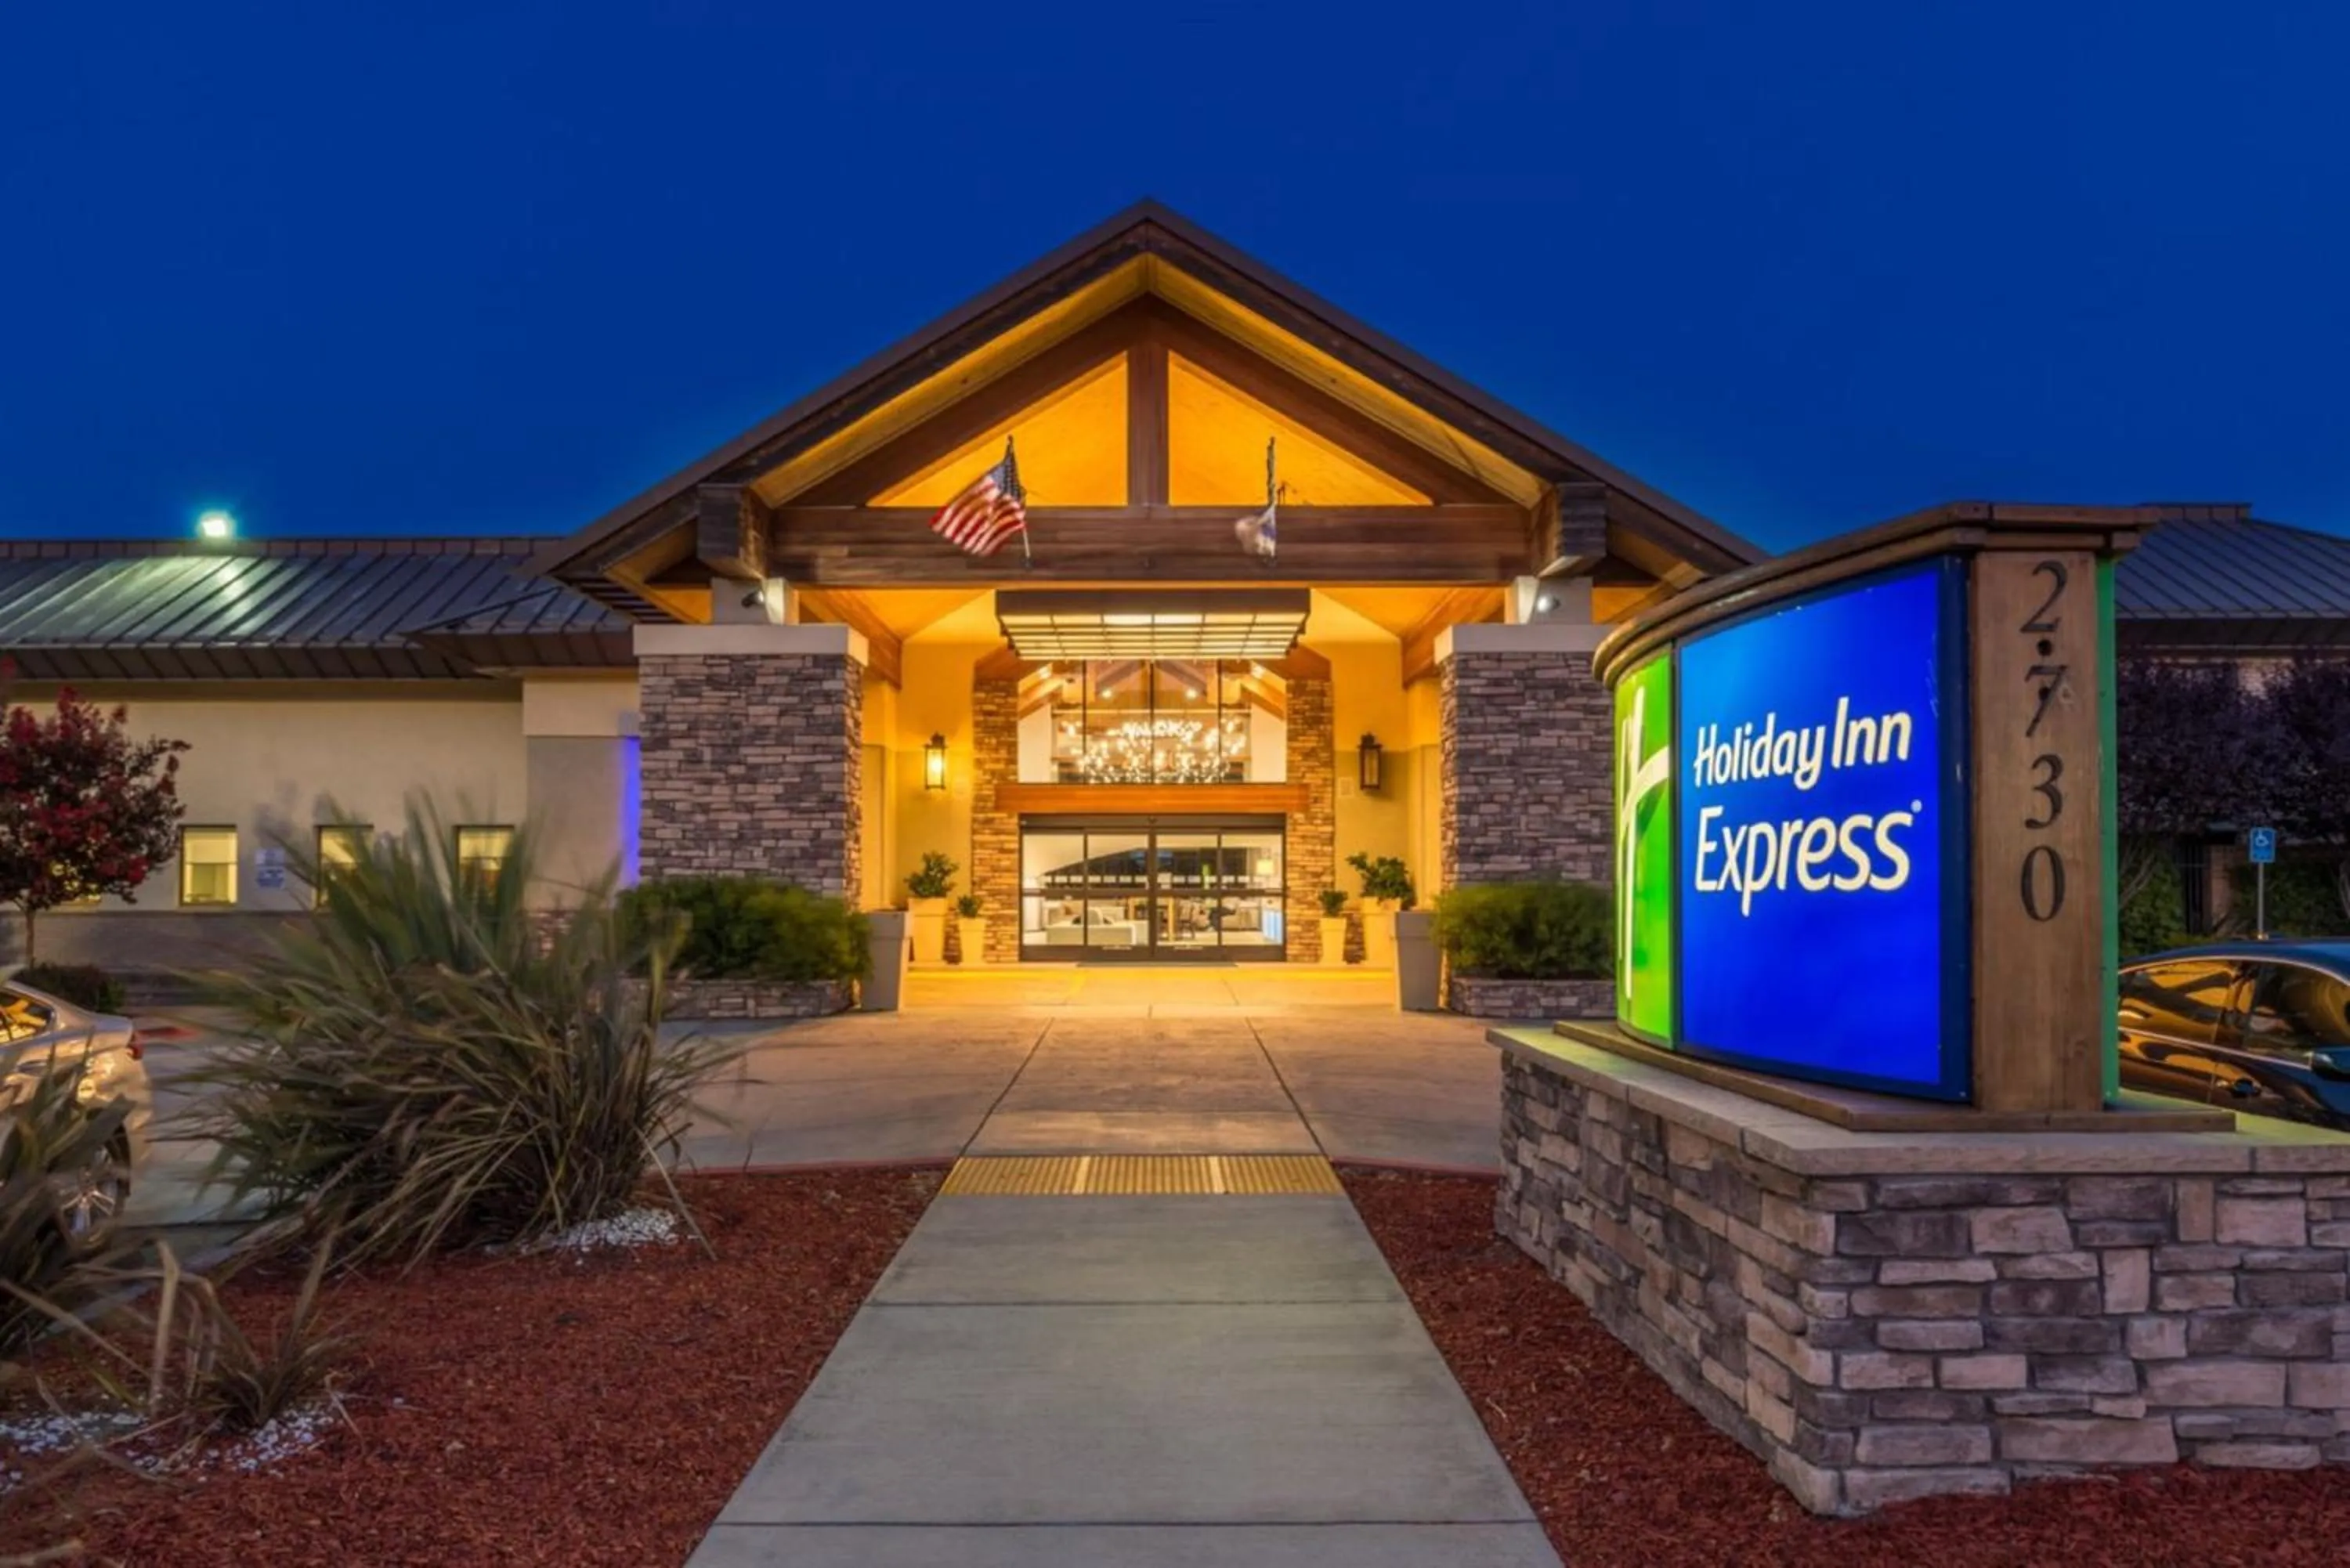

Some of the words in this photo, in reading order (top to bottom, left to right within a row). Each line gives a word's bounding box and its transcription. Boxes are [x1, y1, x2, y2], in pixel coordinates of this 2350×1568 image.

[1694, 712, 1826, 790] Holiday
[1831, 696, 1911, 769] Inn
[1694, 801, 1914, 916] Express
